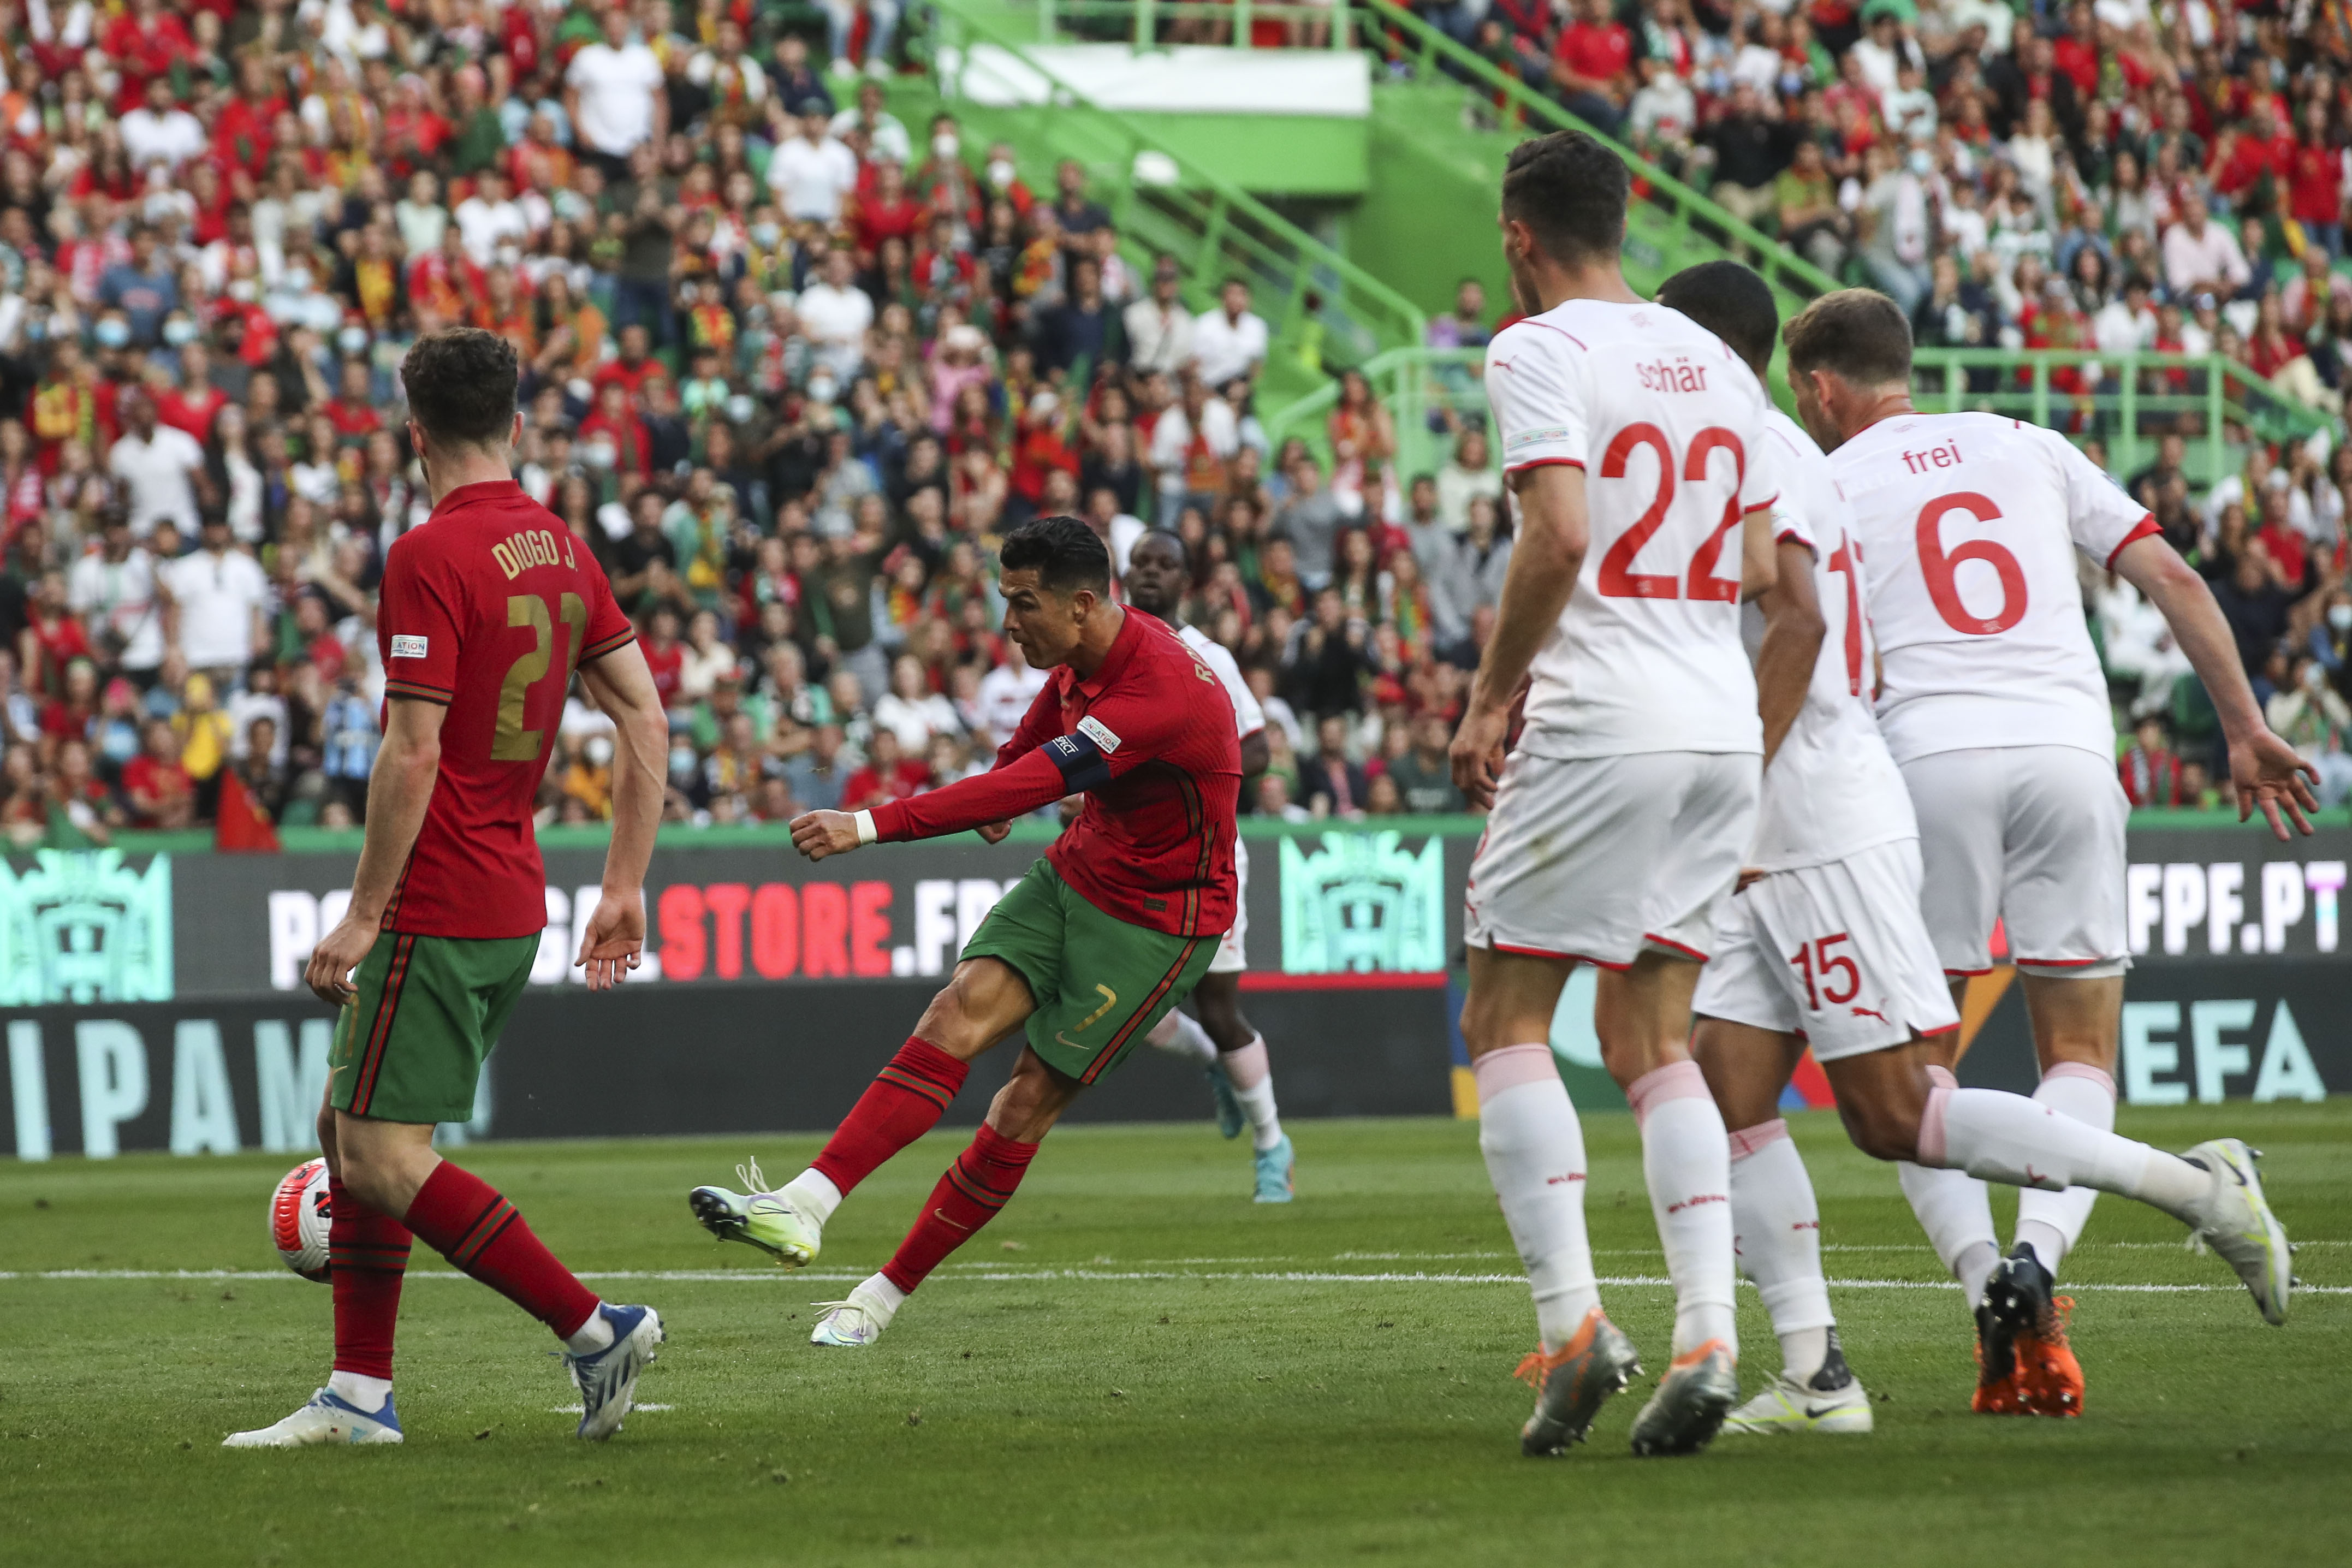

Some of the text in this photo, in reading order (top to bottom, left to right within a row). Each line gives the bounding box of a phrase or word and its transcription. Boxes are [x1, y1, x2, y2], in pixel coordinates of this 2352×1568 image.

[1902, 438, 1963, 474] frei
[491, 530, 559, 580] DIOGO
[1598, 420, 1744, 604] 22
[1916, 491, 2027, 634] 6
[490, 592, 587, 761] 21
[1055, 736, 1076, 753] SPECT
[2128, 860, 2347, 955] FPF.PT
[1074, 983, 1116, 1034] 7
[1791, 932, 1861, 1010] 15
[2121, 997, 2327, 1105] EFA
